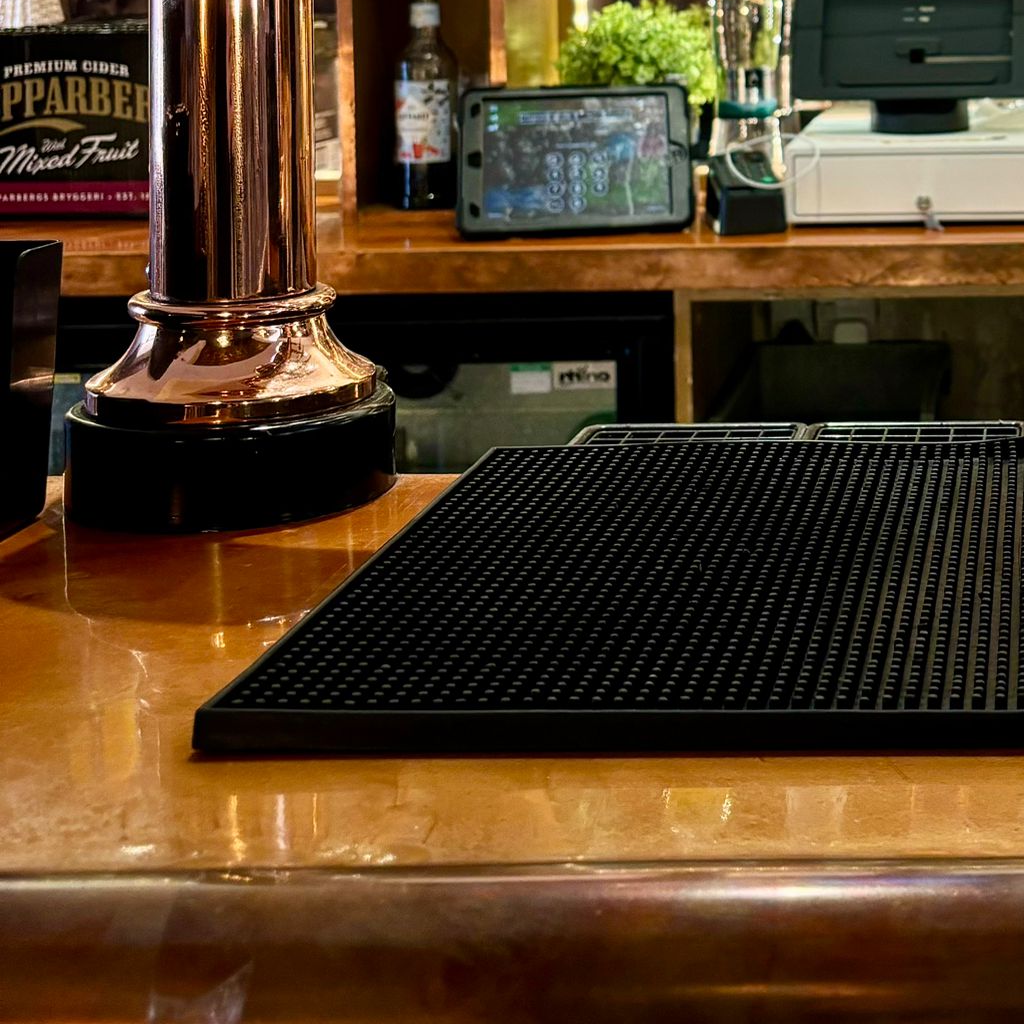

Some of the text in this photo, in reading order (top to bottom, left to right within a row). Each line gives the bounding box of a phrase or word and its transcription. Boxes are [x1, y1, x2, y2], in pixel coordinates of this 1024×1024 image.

[4, 59, 130, 80] PREMIUM CIDER
[0, 131, 140, 176] Mixed Fruit
[0, 192, 49, 203] ARBERGS
